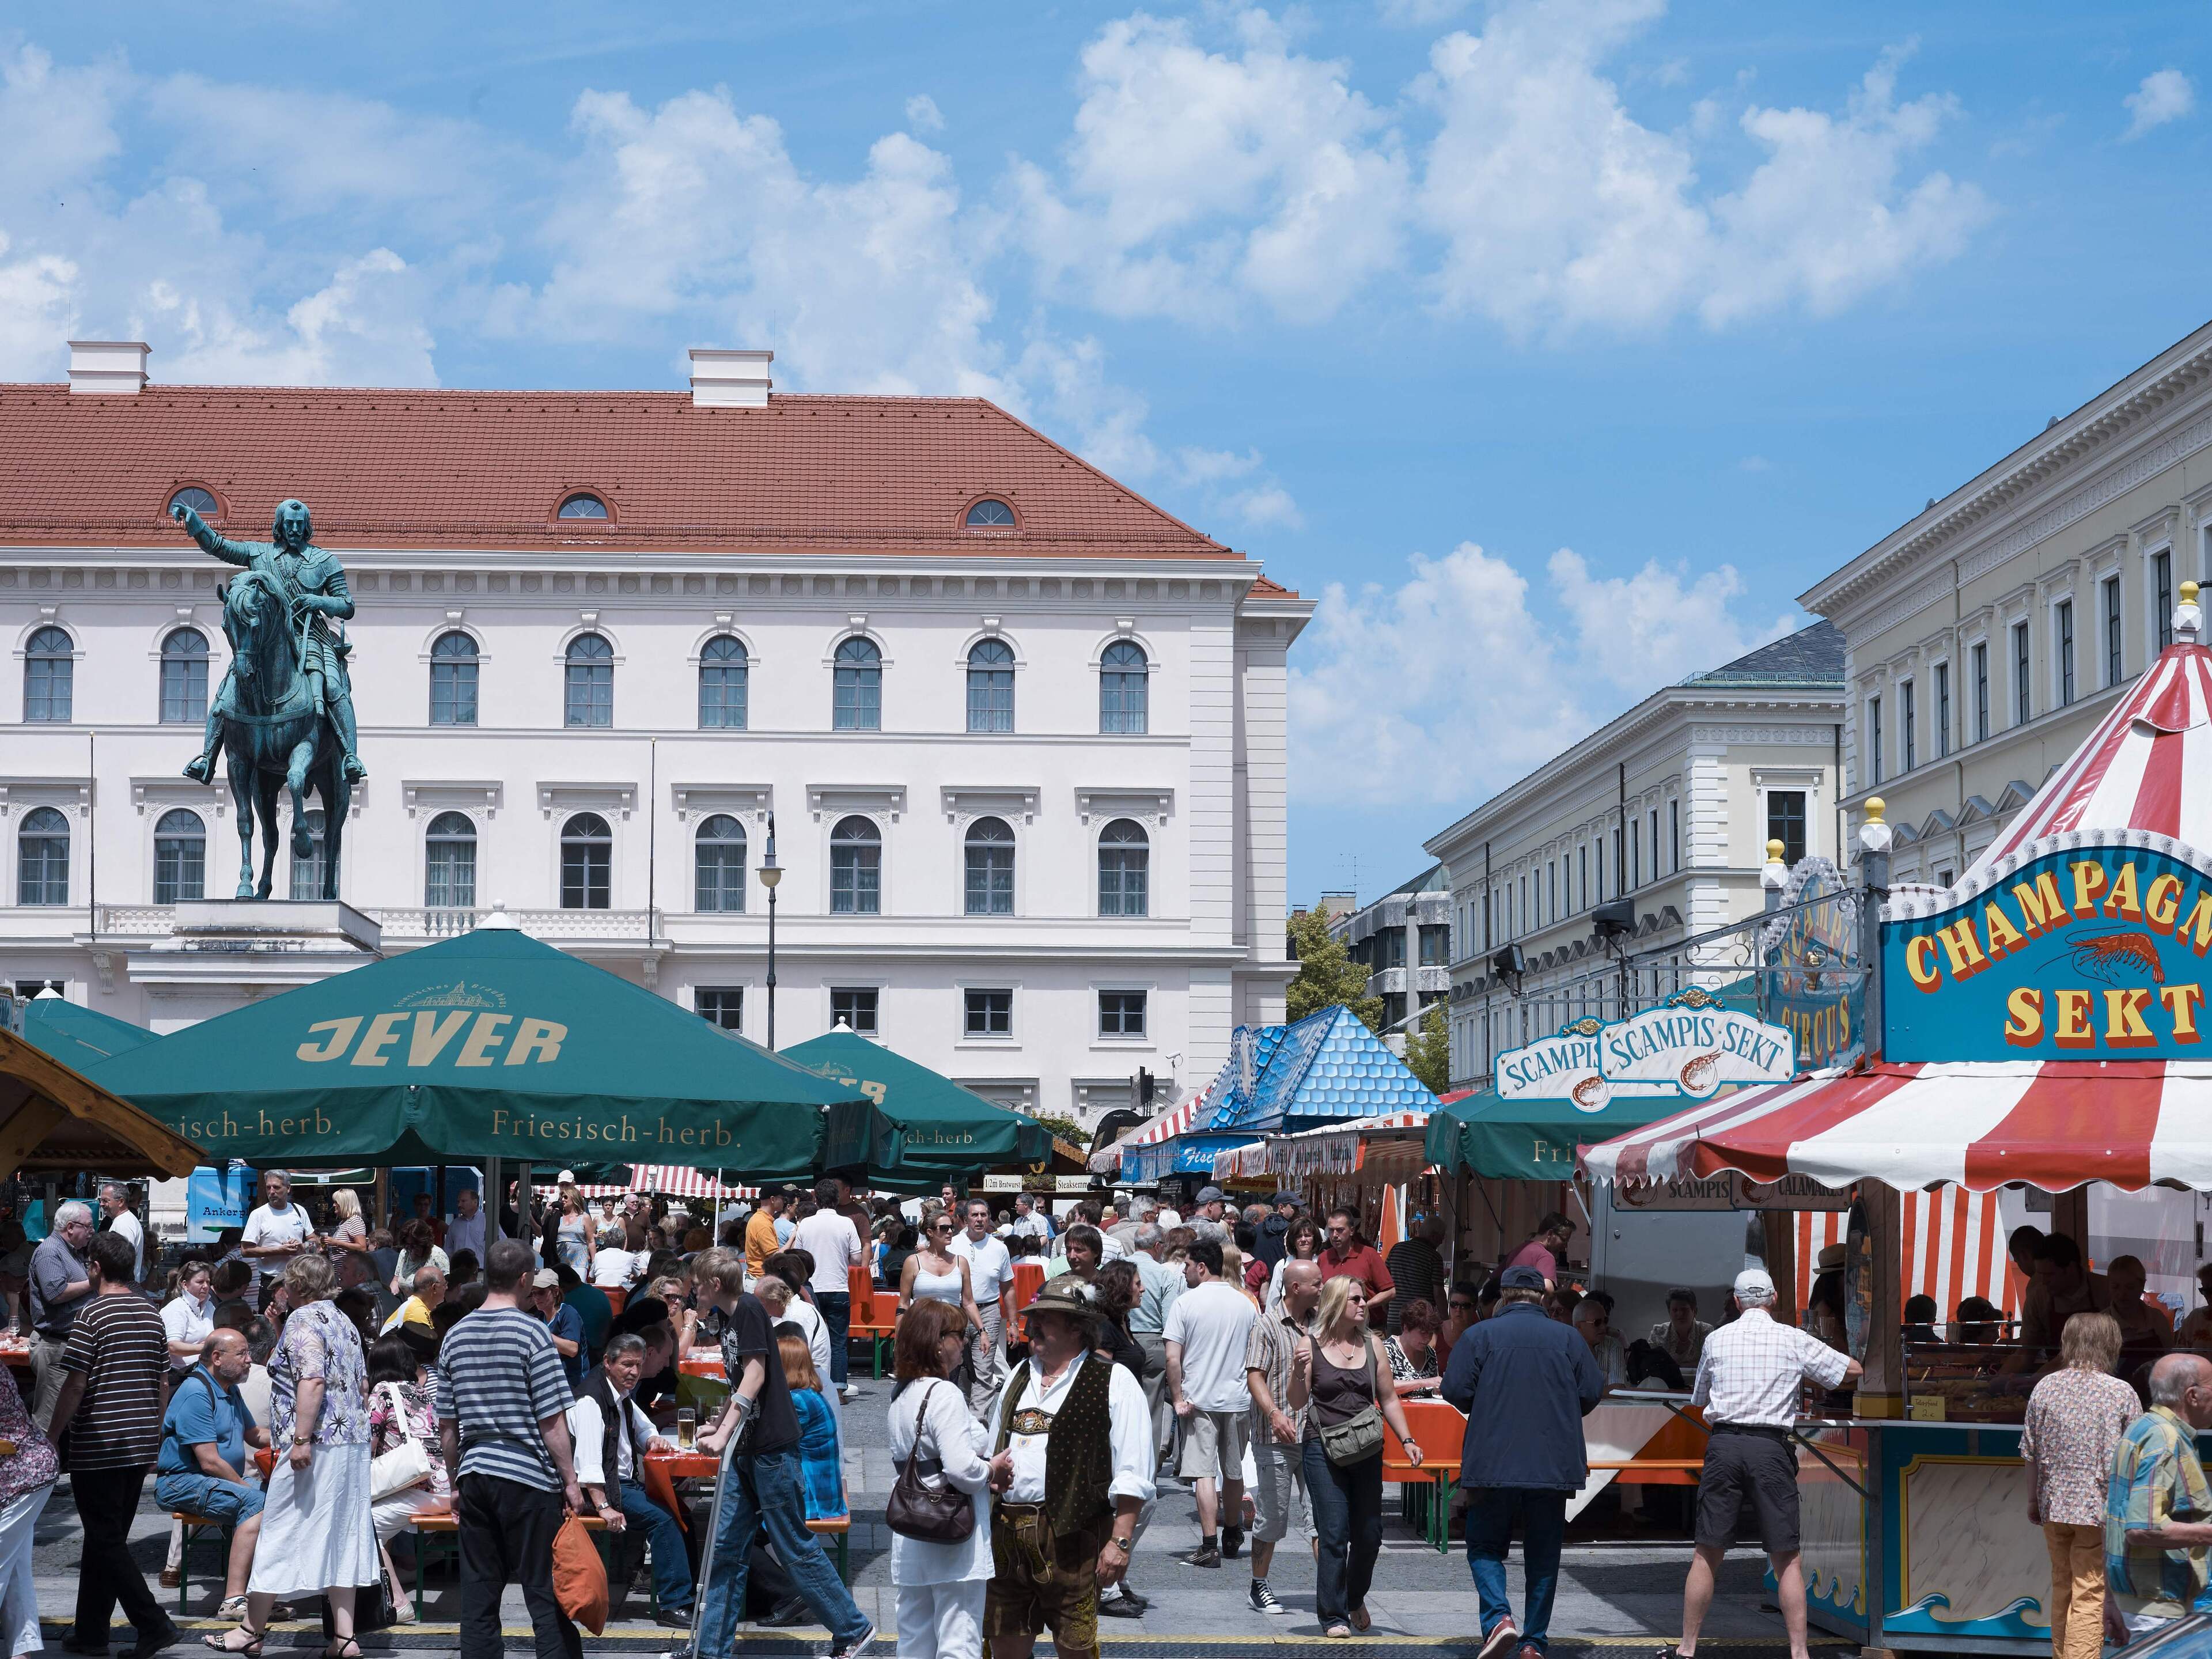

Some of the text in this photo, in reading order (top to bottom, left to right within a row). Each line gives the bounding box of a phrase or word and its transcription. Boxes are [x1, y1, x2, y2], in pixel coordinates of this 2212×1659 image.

[393, 983, 507, 1008] Friesisches Brauhaus
[2005, 983, 2205, 1049] SEKT
[296, 1010, 568, 1066] JEVER
[1609, 1016, 1785, 1073] SCAMPIS SEKT
[1505, 1041, 1599, 1091] SCAMPI
[491, 1109, 742, 1148] Friesisch-herb.
[1533, 1141, 1572, 1162] Fri
[999, 1180, 1020, 1188] Bratwurst
[1669, 1181, 1729, 1198] SCAMPIS
